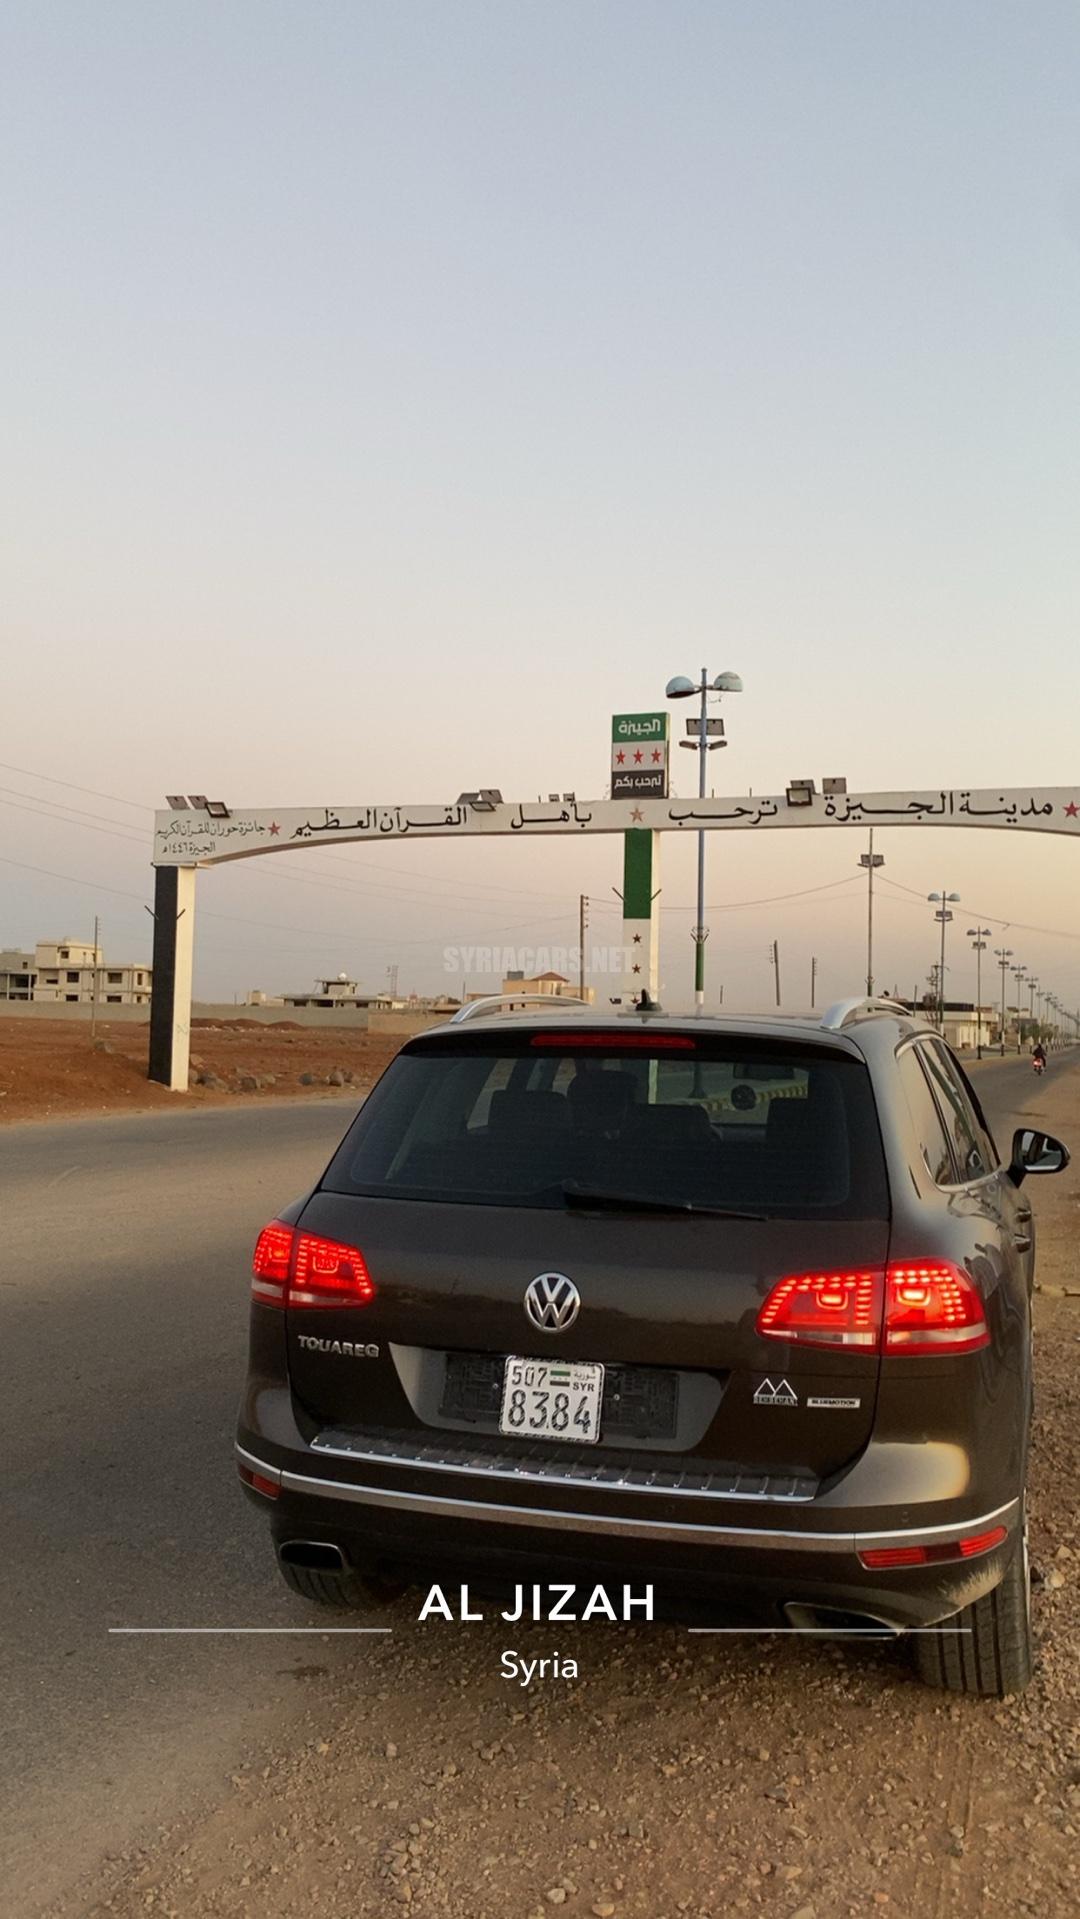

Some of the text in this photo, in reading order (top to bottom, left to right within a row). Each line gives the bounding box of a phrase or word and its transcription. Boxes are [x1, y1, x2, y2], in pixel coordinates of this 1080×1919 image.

[618, 718, 661, 736] الجيزة
[614, 775, 634, 789] بكم
[668, 800, 778, 825] ترحب
[824, 790, 954, 821] الجيزة
[959, 791, 1053, 823] مدينة
[155, 820, 182, 840] الكريم
[210, 821, 239, 838] حوران
[289, 807, 377, 840] العظيم
[379, 806, 467, 833] القرآن
[189, 841, 216, 856] الجيزة
[297, 1334, 380, 1358] TOUAREG
[511, 1365, 548, 1388] 507
[572, 1382, 595, 1392] SYR
[508, 1389, 591, 1434] 8384
